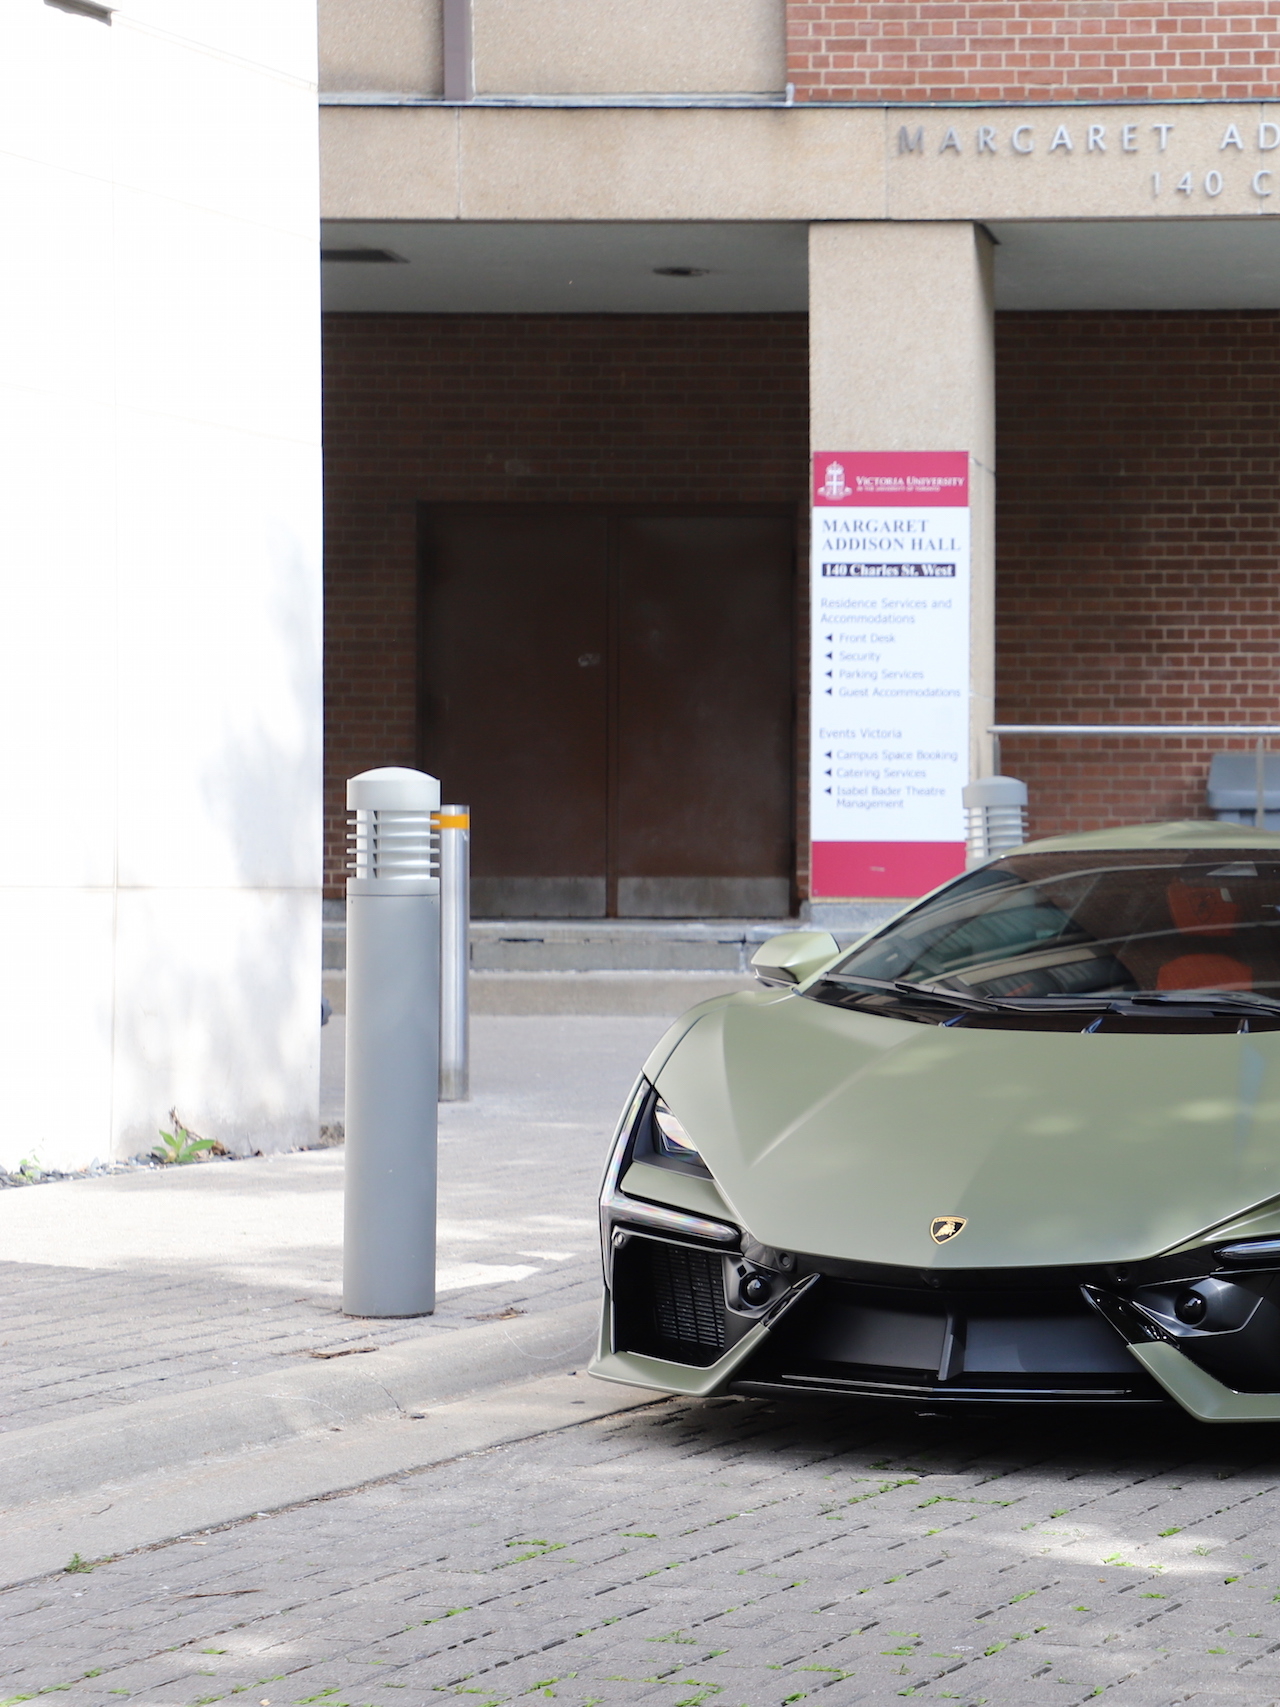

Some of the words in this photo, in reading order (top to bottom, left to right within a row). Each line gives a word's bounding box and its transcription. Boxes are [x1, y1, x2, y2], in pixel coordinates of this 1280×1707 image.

[898, 124, 1174, 154] MARGARET
[1151, 170, 1224, 197] 140
[822, 519, 929, 533] MARGARET
[822, 537, 905, 551] ADDISON
[911, 537, 961, 551] HALL
[825, 564, 847, 576] 140
[850, 564, 898, 576] Charles
[901, 564, 919, 576] St.
[922, 564, 953, 576] West
[821, 598, 877, 608] Residence
[881, 598, 927, 608] Services
[931, 599, 952, 608] and
[821, 613, 915, 624] Accommodations
[839, 633, 866, 643] Front
[871, 633, 895, 643] Desk
[839, 651, 881, 661] Security
[839, 669, 878, 680] Parking
[881, 669, 924, 679] Services
[839, 687, 869, 697] Guest
[872, 687, 961, 697] Accommodations
[819, 728, 856, 738] Events
[860, 728, 902, 738] Victoria
[836, 750, 878, 762] Campus
[882, 750, 912, 762] Space
[916, 750, 958, 762] Booking
[836, 768, 880, 779] Catering
[884, 768, 926, 778] Services
[906, 786, 945, 796] Theatre
[836, 799, 903, 810] Management
